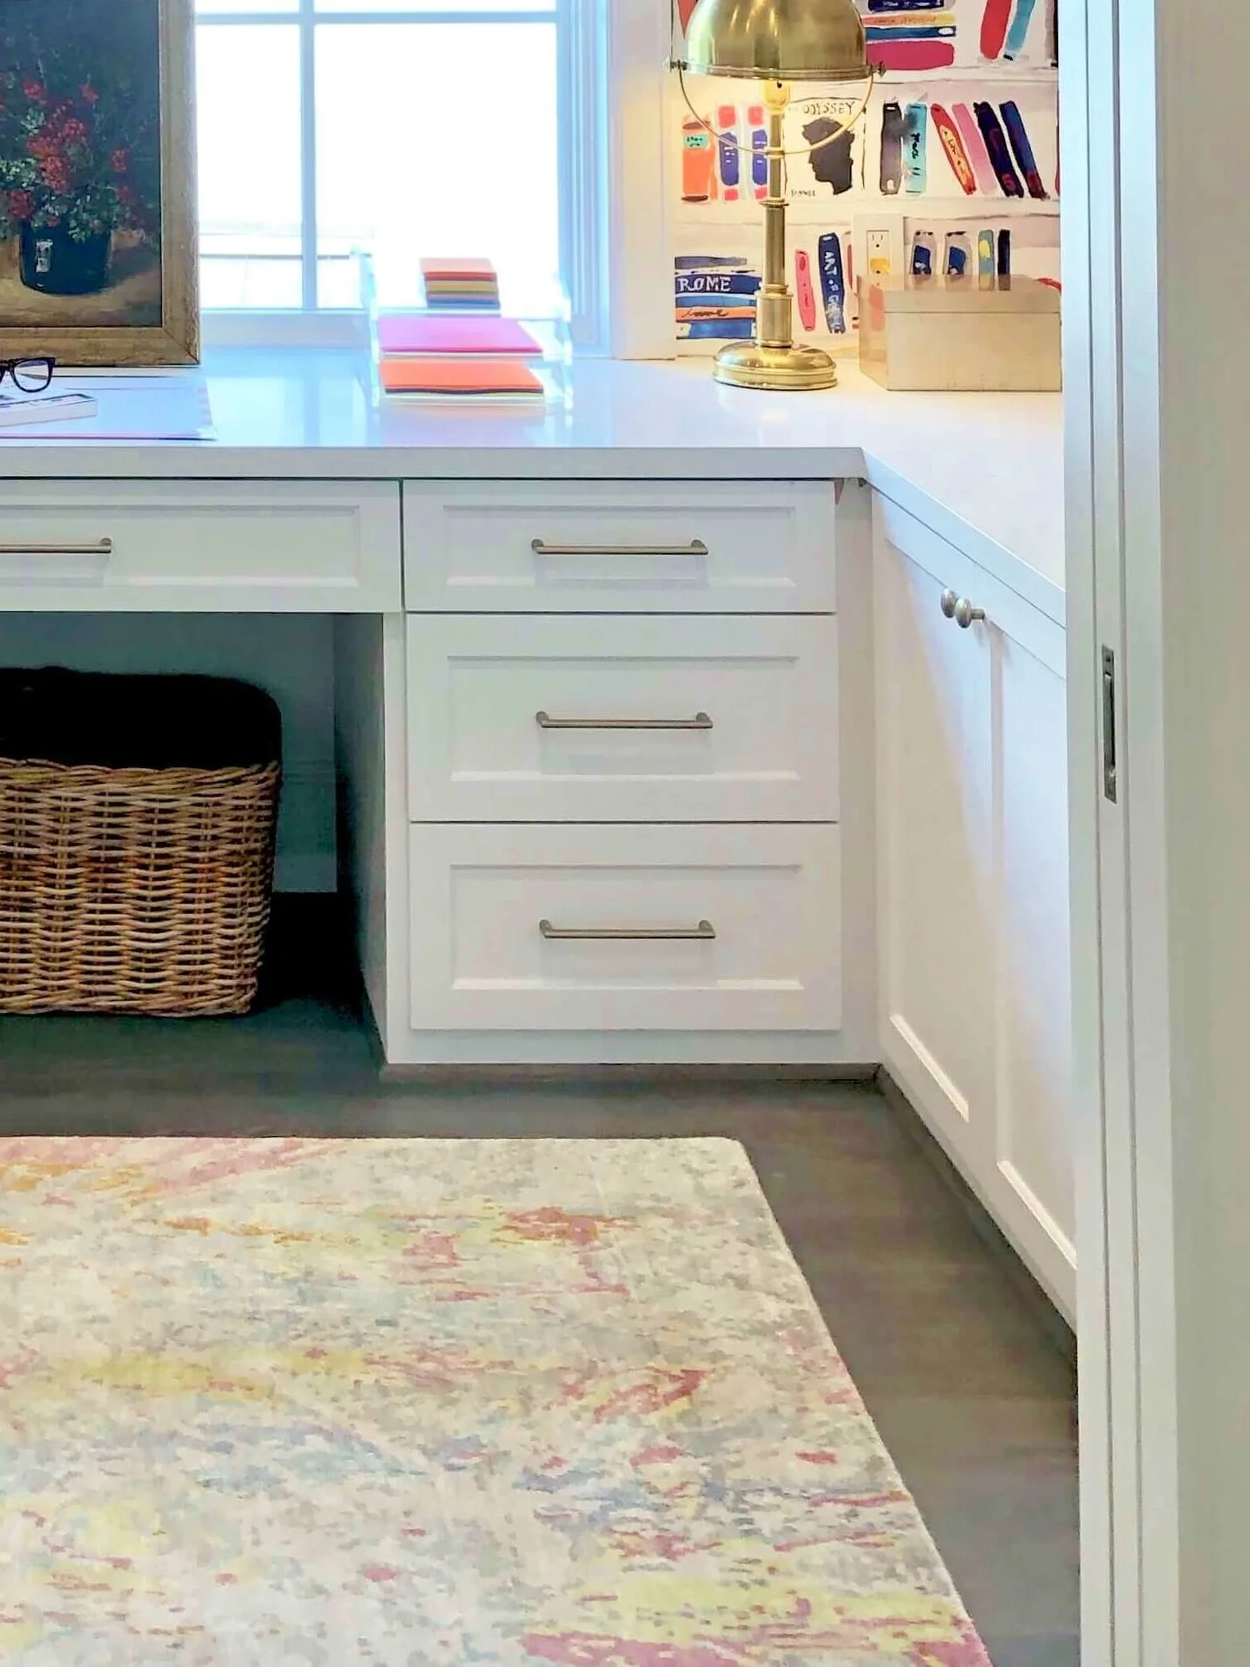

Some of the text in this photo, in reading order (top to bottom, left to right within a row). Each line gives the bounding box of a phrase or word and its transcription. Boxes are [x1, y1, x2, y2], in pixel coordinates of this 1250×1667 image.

[803, 101, 856, 116] ODYSSEY
[824, 251, 838, 276] ART
[678, 276, 731, 292] ROME
